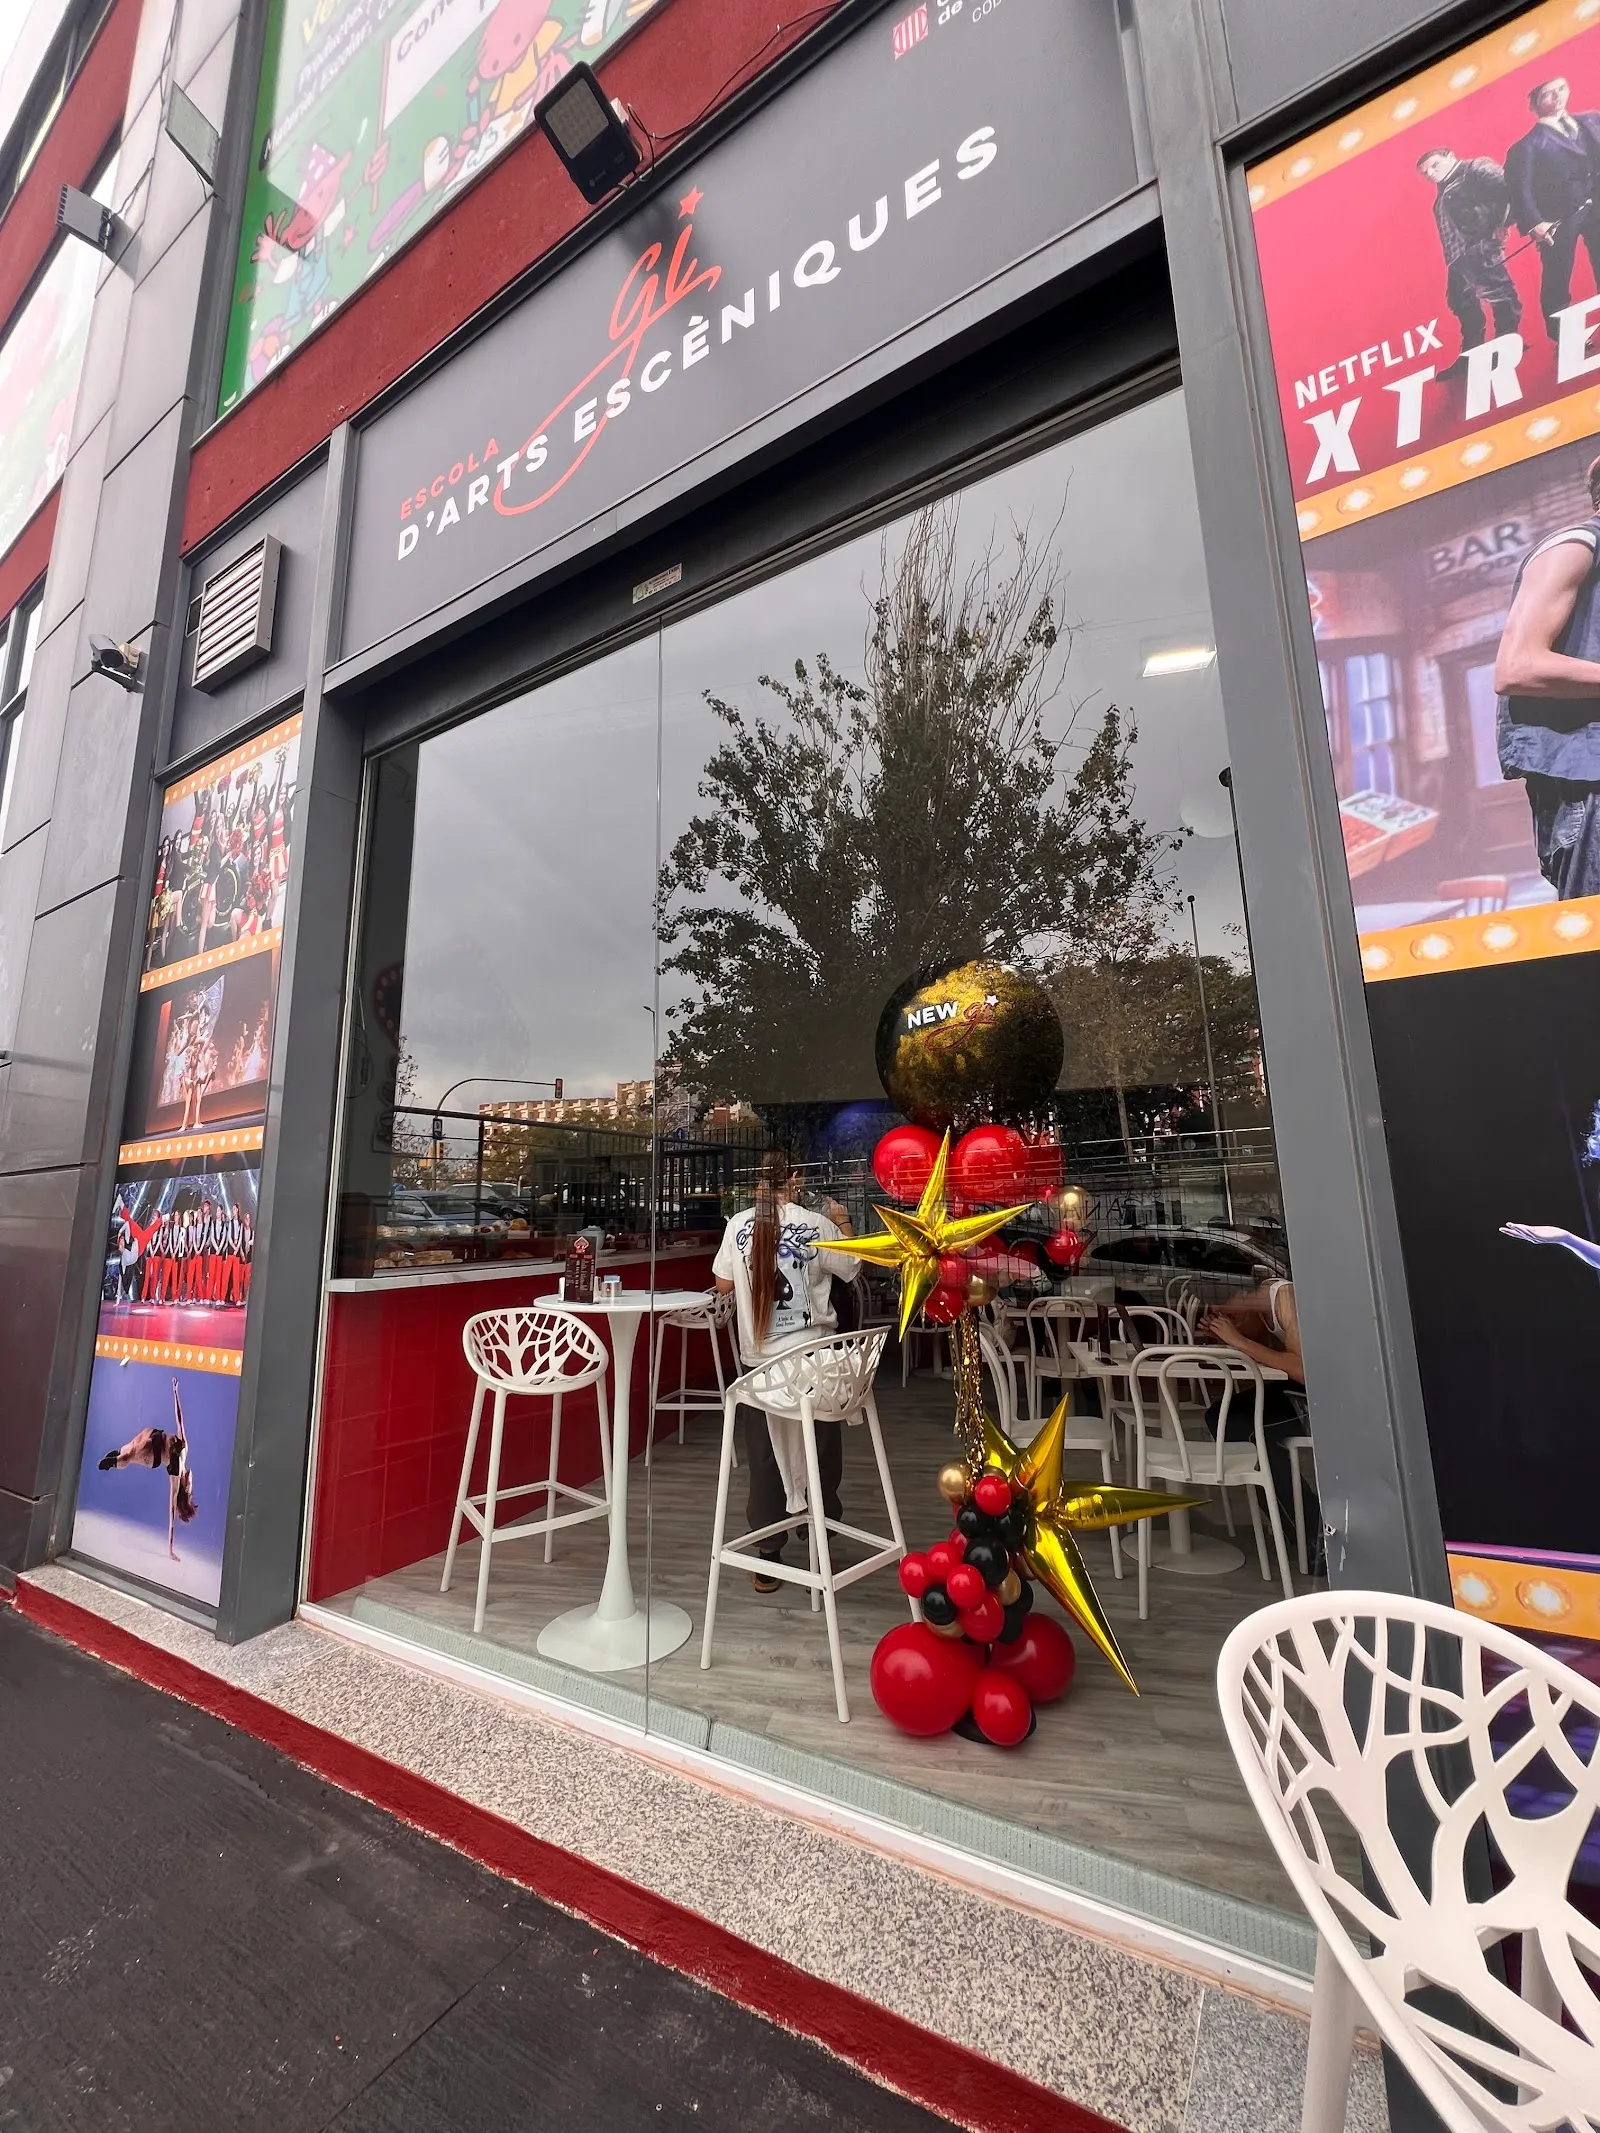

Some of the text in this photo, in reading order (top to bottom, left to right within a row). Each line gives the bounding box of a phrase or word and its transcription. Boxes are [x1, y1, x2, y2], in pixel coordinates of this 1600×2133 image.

[937, 0, 963, 25] de
[397, 125, 998, 561] D'ARTS ESCÈNIQUES
[1294, 318, 1444, 410] NETFLIX
[400, 438, 499, 521] ESCOLA
[1429, 522, 1526, 575] BAR
[907, 1000, 959, 1029] NEW
